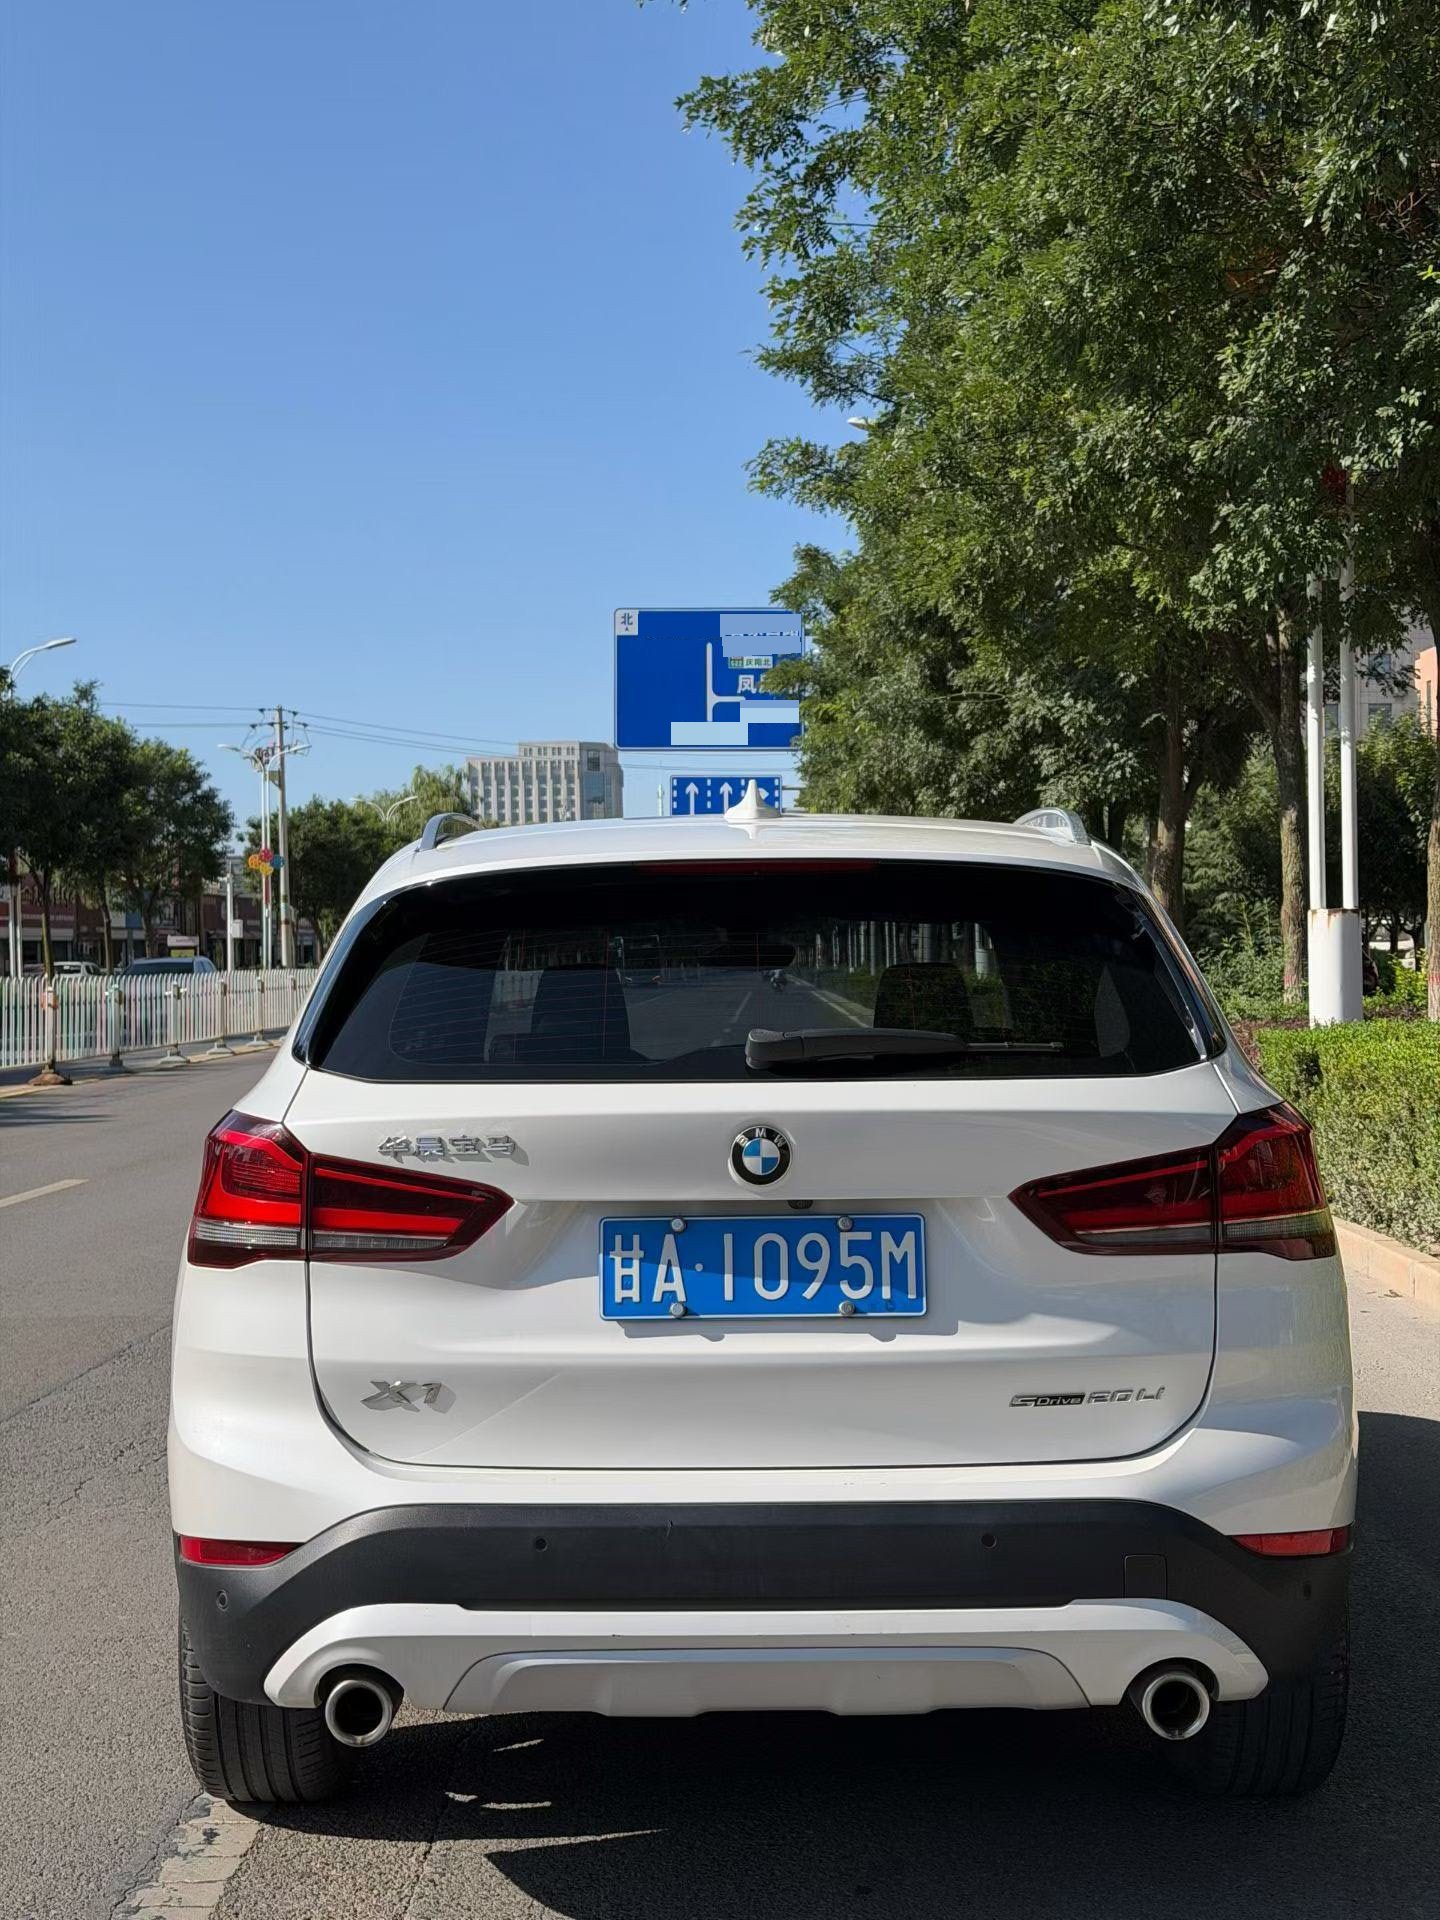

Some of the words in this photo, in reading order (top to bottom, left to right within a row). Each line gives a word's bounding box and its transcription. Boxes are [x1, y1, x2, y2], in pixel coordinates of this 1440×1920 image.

[620, 612, 634, 626] 北
[377, 1134, 516, 1157] 华晨宝马
[736, 1127, 787, 1148] BMW
[359, 1380, 442, 1405] X1
